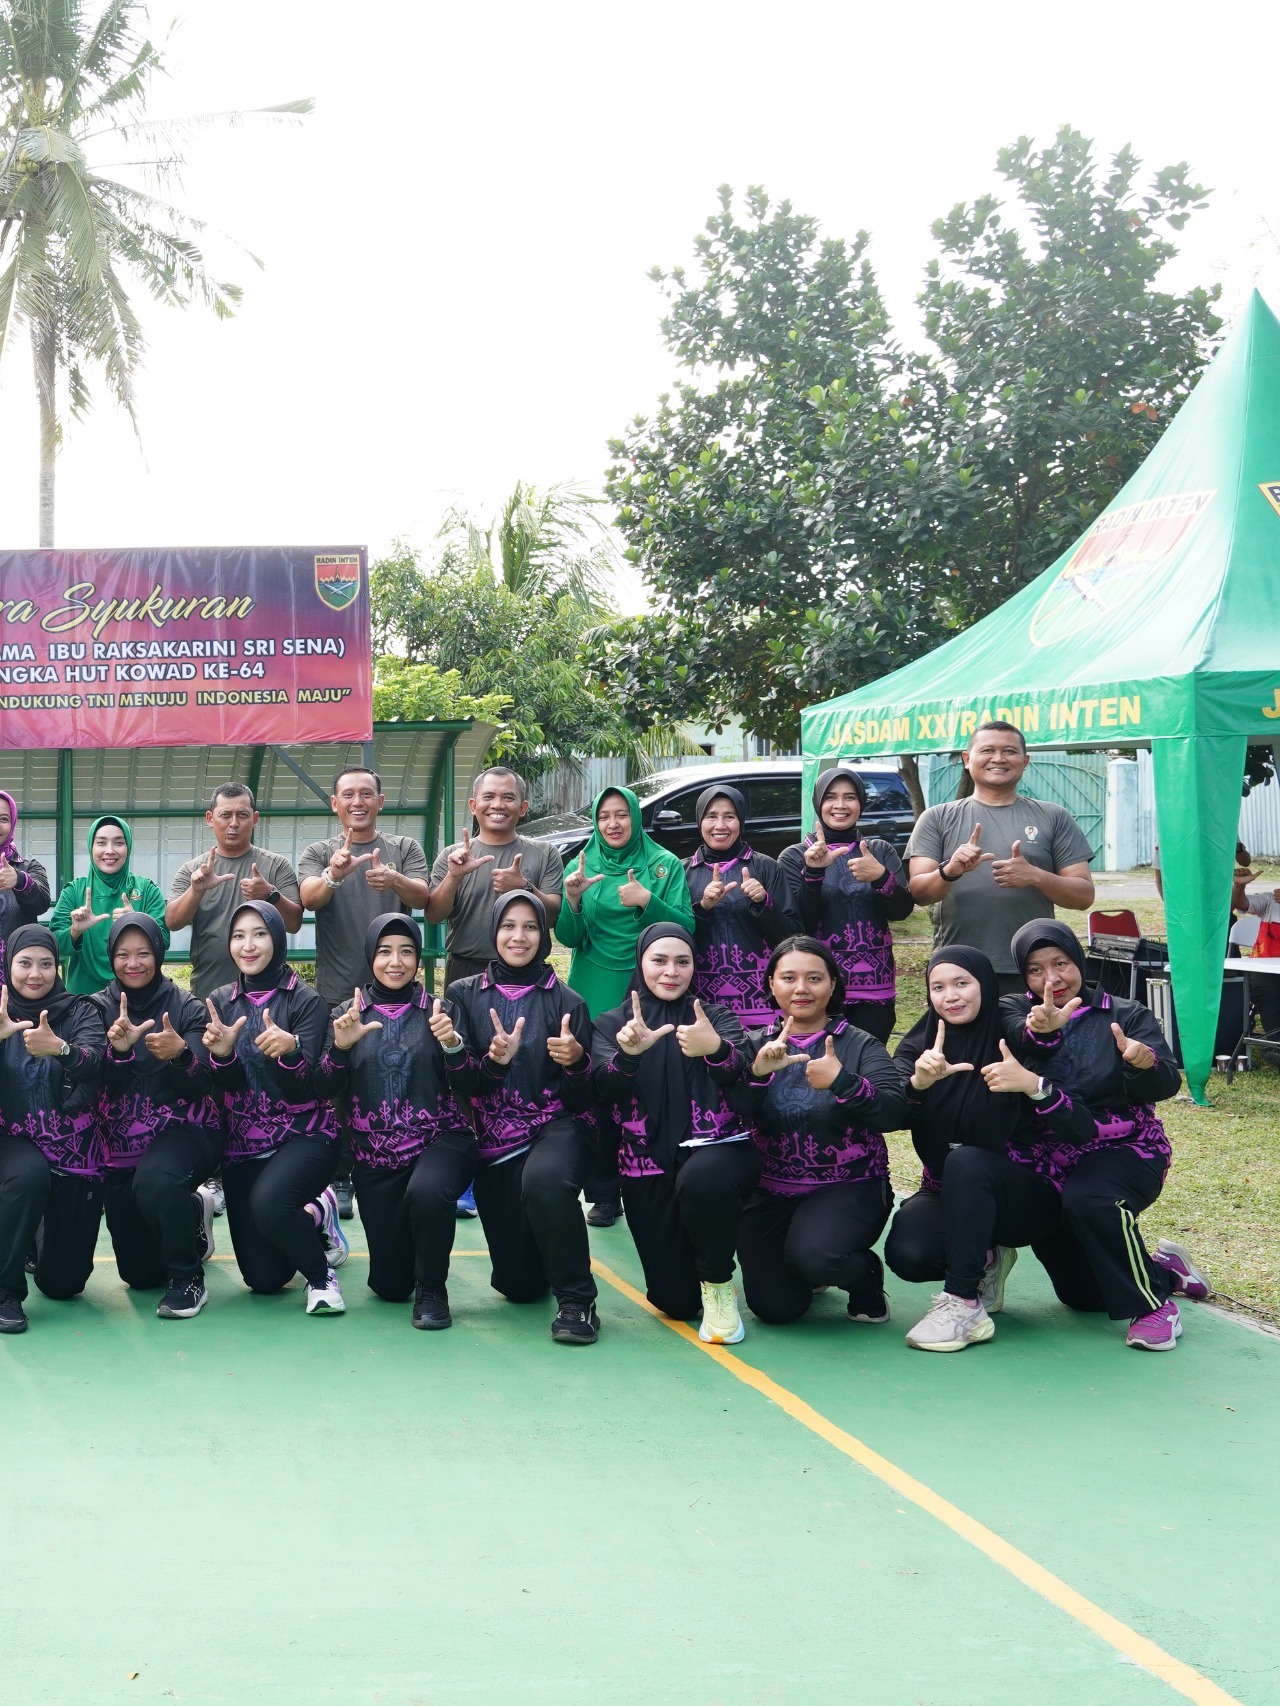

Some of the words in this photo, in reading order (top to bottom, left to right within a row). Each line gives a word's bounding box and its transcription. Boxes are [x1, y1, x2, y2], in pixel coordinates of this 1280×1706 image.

[41, 582, 256, 640] Syukuran
[49, 643, 85, 660] IBU
[93, 640, 236, 660] RAKSAKARINI
[243, 639, 275, 657] SRI
[282, 637, 346, 659] SENA)
[65, 665, 109, 682] HUT
[116, 664, 196, 681] KOWAD
[203, 662, 265, 679] KE-64
[86, 694, 114, 708] TNI
[119, 692, 187, 707] MENUJU
[197, 690, 289, 705] INDONESIA
[829, 717, 910, 747] JASDAM
[1050, 696, 1141, 730] INTEN
